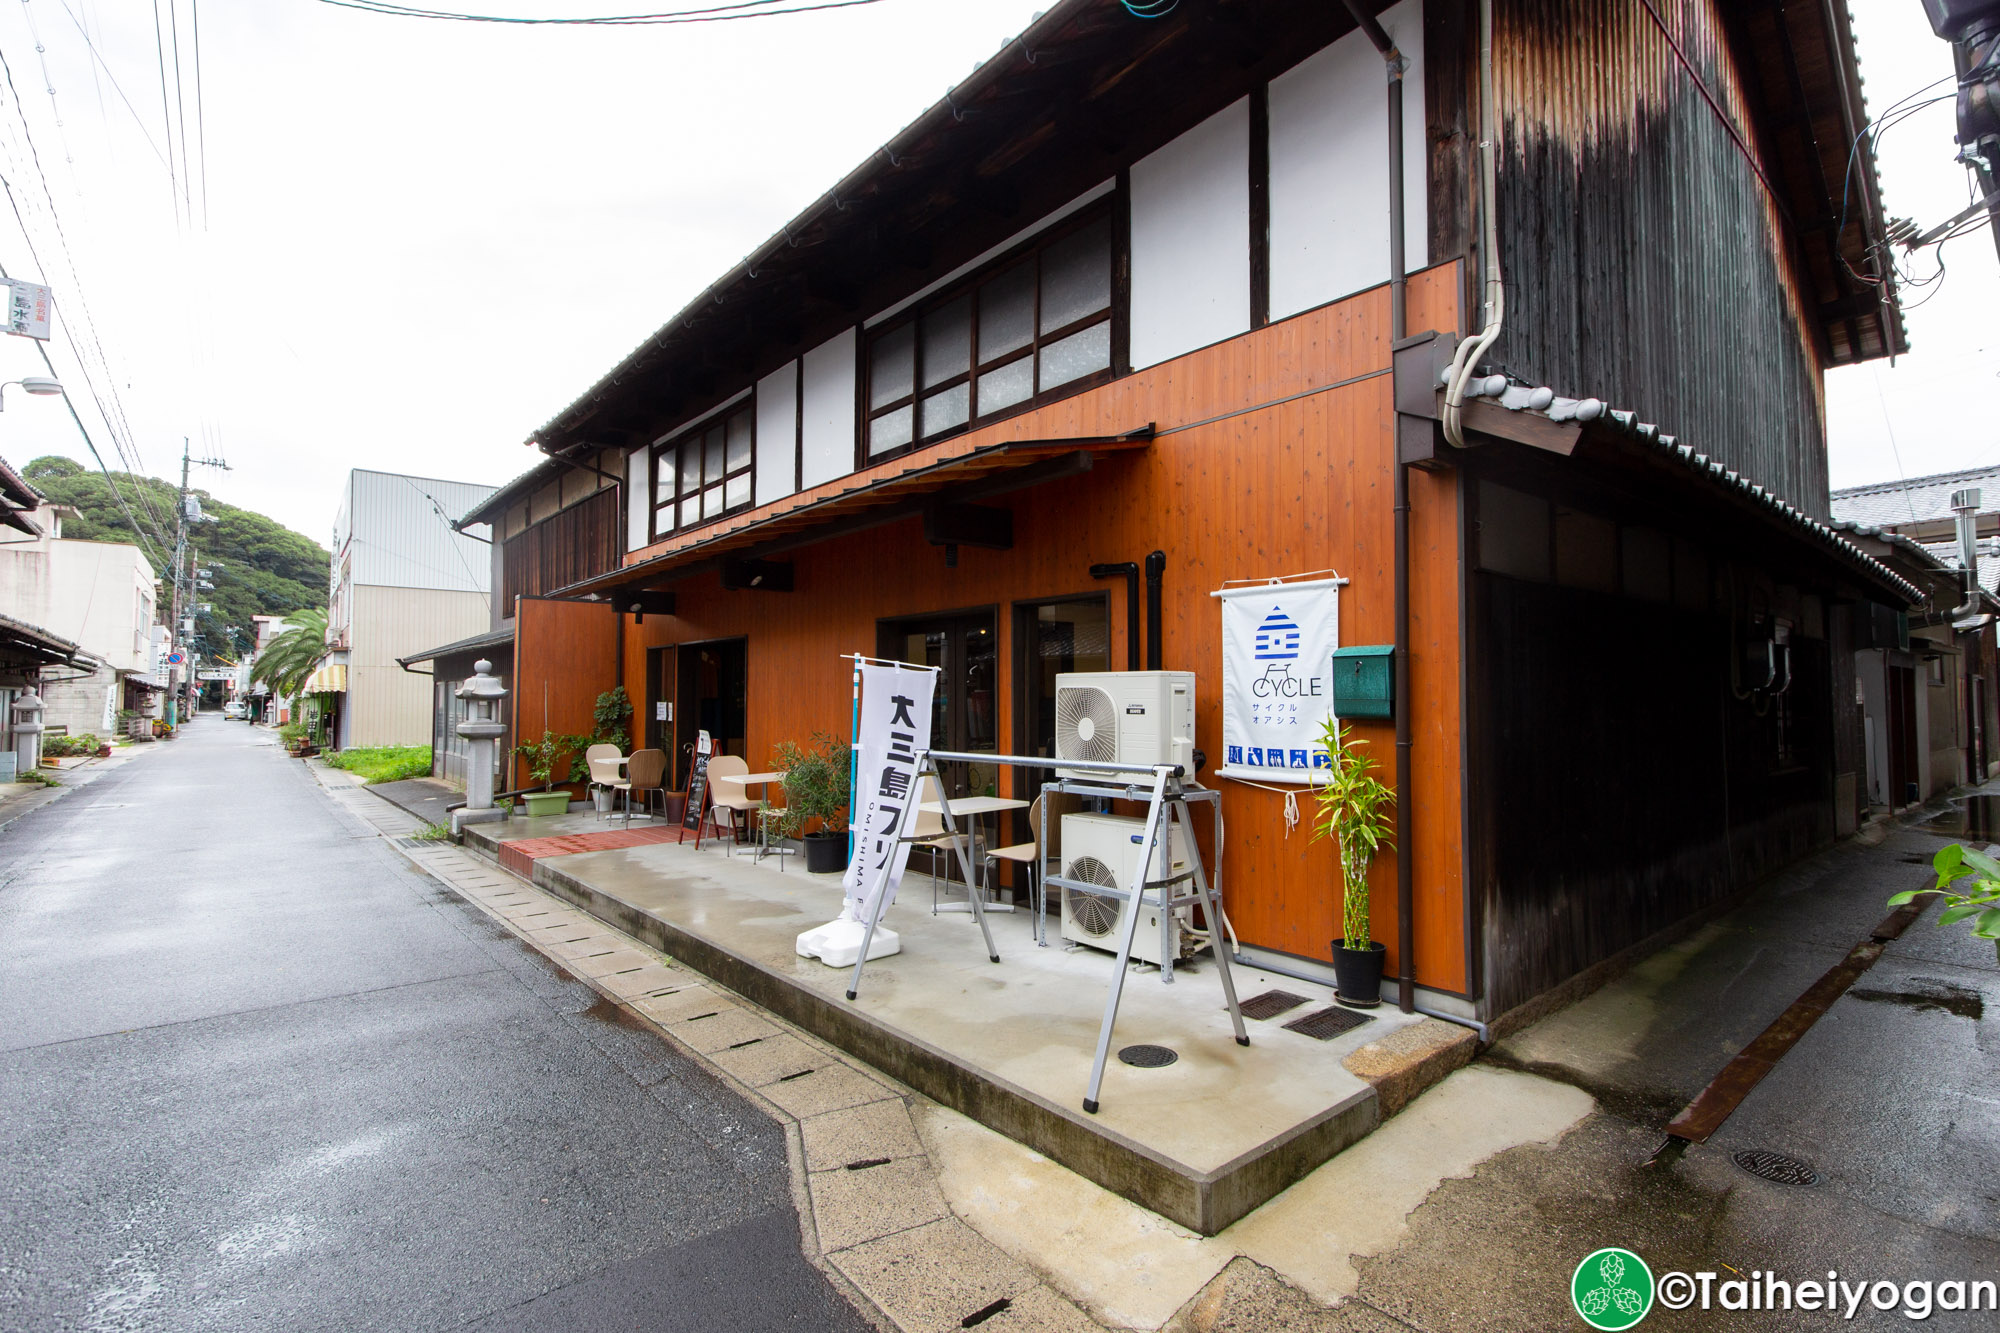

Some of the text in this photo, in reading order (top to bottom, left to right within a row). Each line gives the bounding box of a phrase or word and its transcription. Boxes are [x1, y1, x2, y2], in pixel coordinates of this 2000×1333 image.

[1252, 677, 1322, 698] CYCLE
[1252, 703, 1298, 712] サイクル
[1252, 715, 1298, 725] オアシス
[856, 801, 875, 888] OMISHIMA
